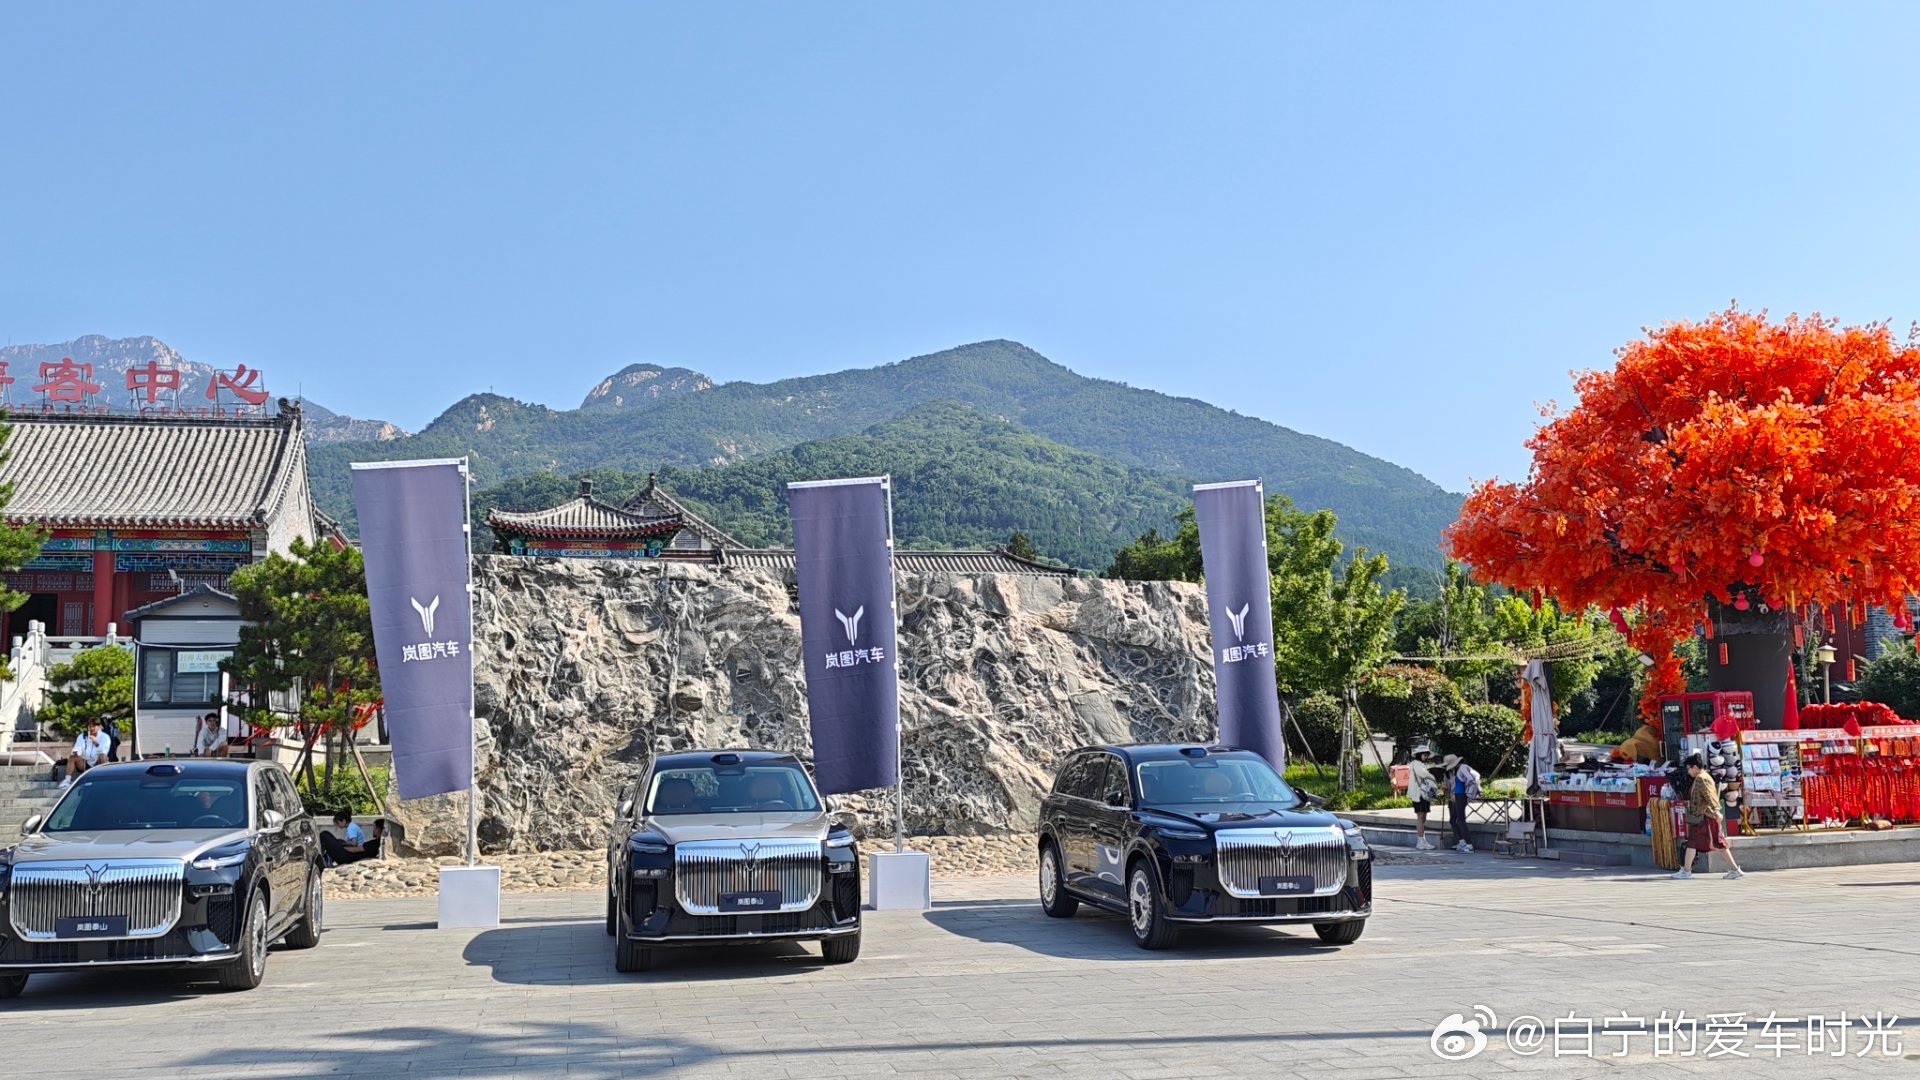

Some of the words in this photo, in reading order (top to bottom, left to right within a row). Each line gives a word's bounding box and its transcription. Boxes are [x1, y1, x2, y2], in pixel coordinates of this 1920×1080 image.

[0, 358, 269, 405] 客中心
[140, 406, 246, 417] CENTRE
[402, 640, 460, 662] 岚图汽车
[825, 646, 885, 669] 岚图汽车
[1222, 641, 1269, 664] 岚图汽车
[77, 922, 108, 932] 岚图泰山
